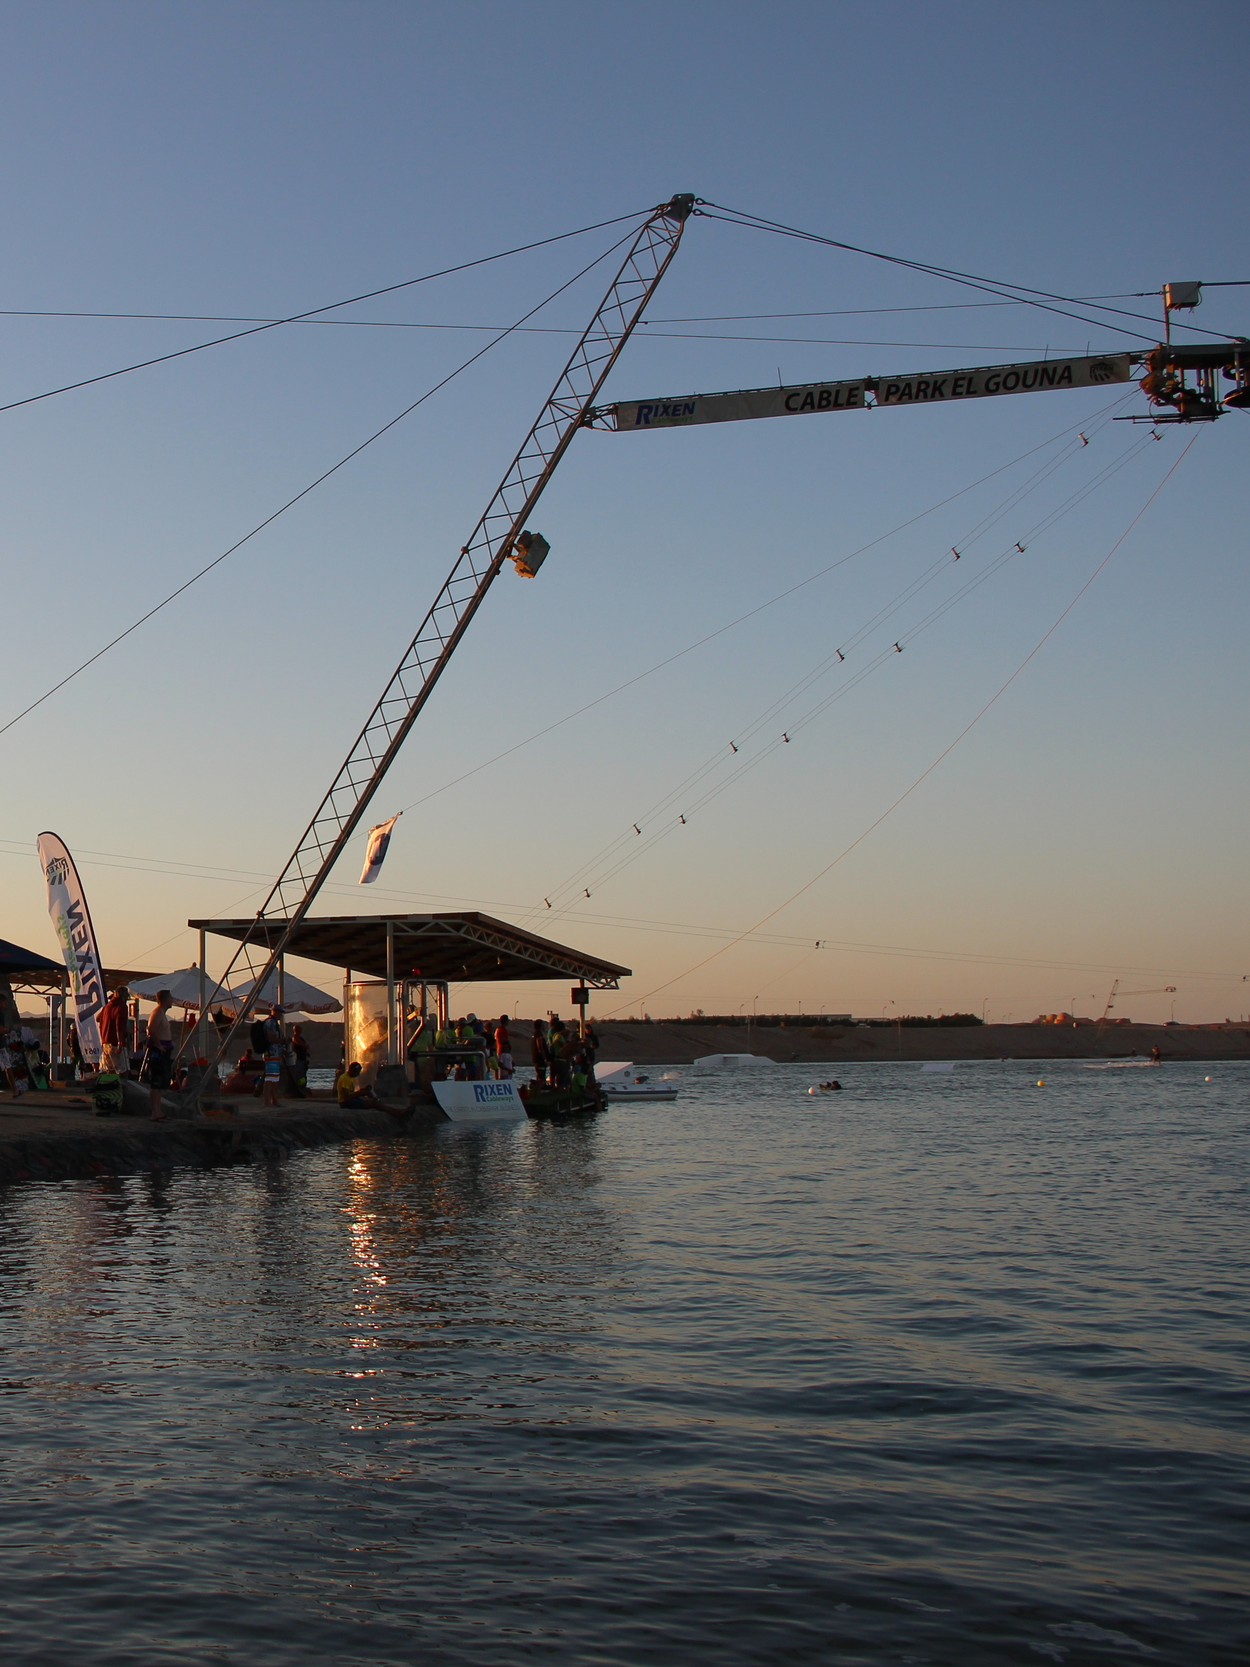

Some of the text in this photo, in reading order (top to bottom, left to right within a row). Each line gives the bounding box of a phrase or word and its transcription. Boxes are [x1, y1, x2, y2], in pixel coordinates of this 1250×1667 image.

[784, 365, 1073, 412] CABLE PARK EL GOUNA
[635, 401, 696, 425] RIXEN
[473, 1083, 513, 1102] RIXEN
[486, 1095, 514, 1103] Cableways
